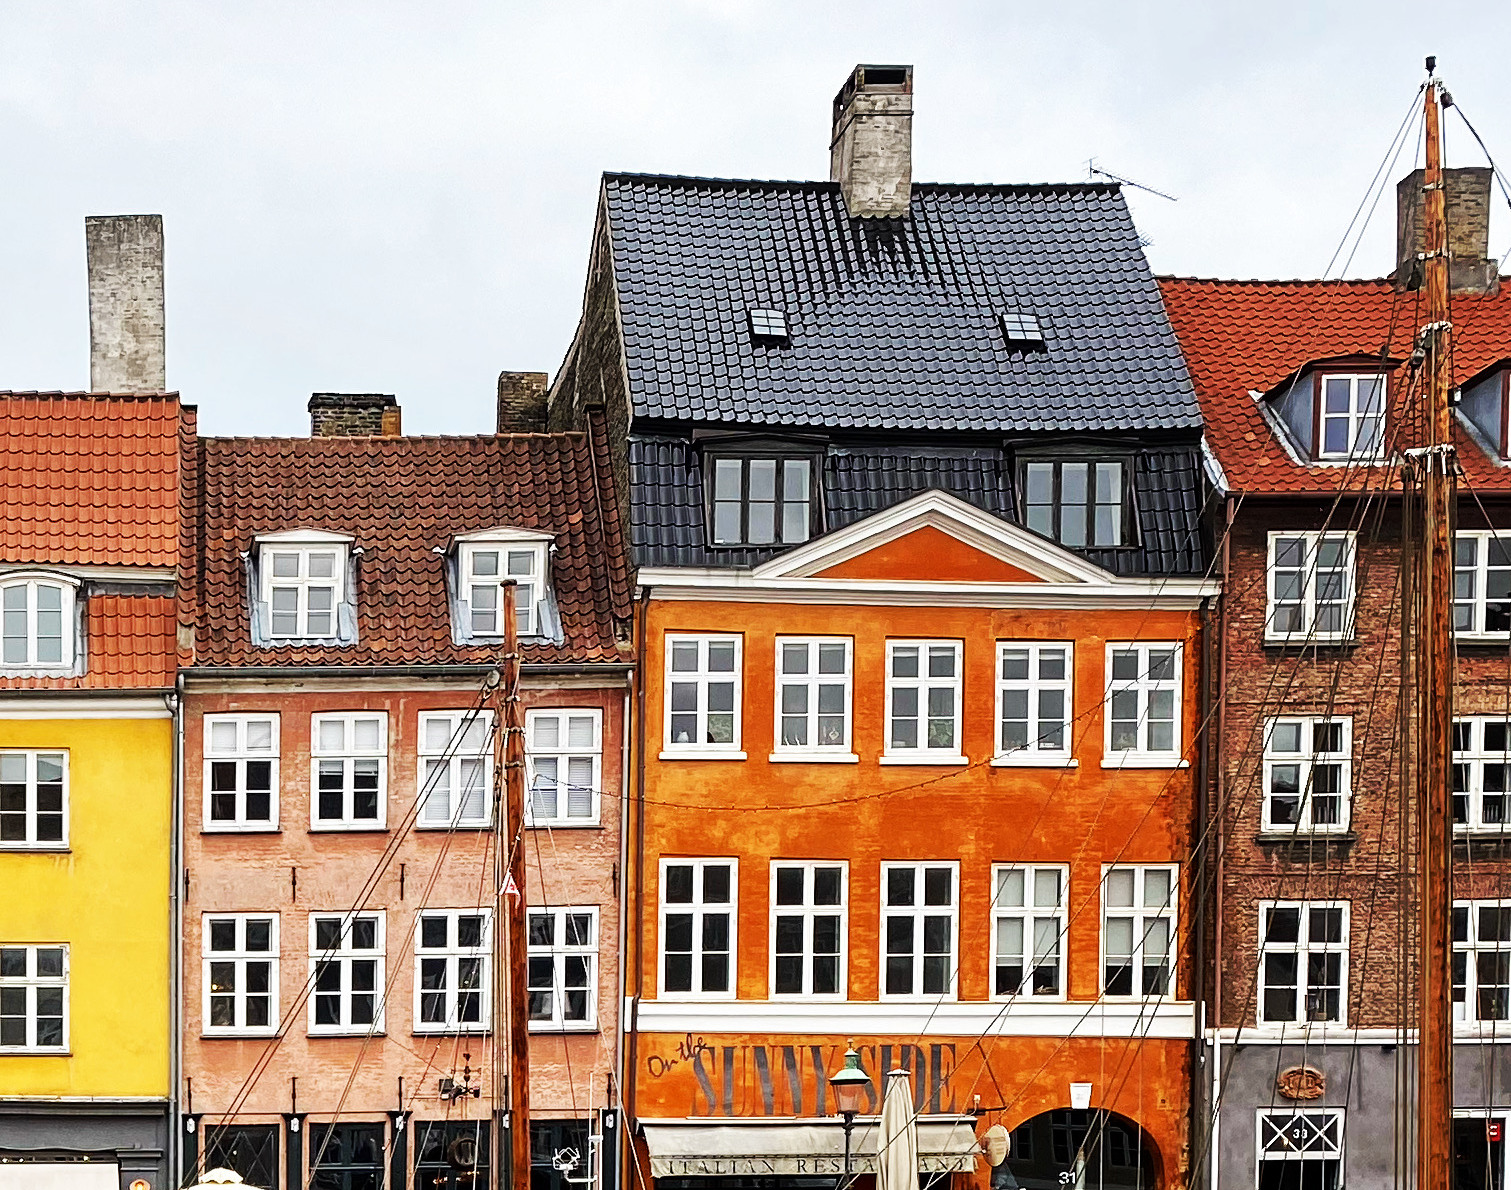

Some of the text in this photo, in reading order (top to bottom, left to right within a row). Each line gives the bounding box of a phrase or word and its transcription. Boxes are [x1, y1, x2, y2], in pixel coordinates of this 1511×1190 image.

[648, 1055, 678, 1078] On
[691, 1044, 839, 1117] SUNNY
[852, 1043, 956, 1115] SIDE
[1293, 1129, 1308, 1139] 33
[668, 1157, 968, 1174] ITALIAN RESTAANT
[1059, 1171, 1076, 1185] 31
